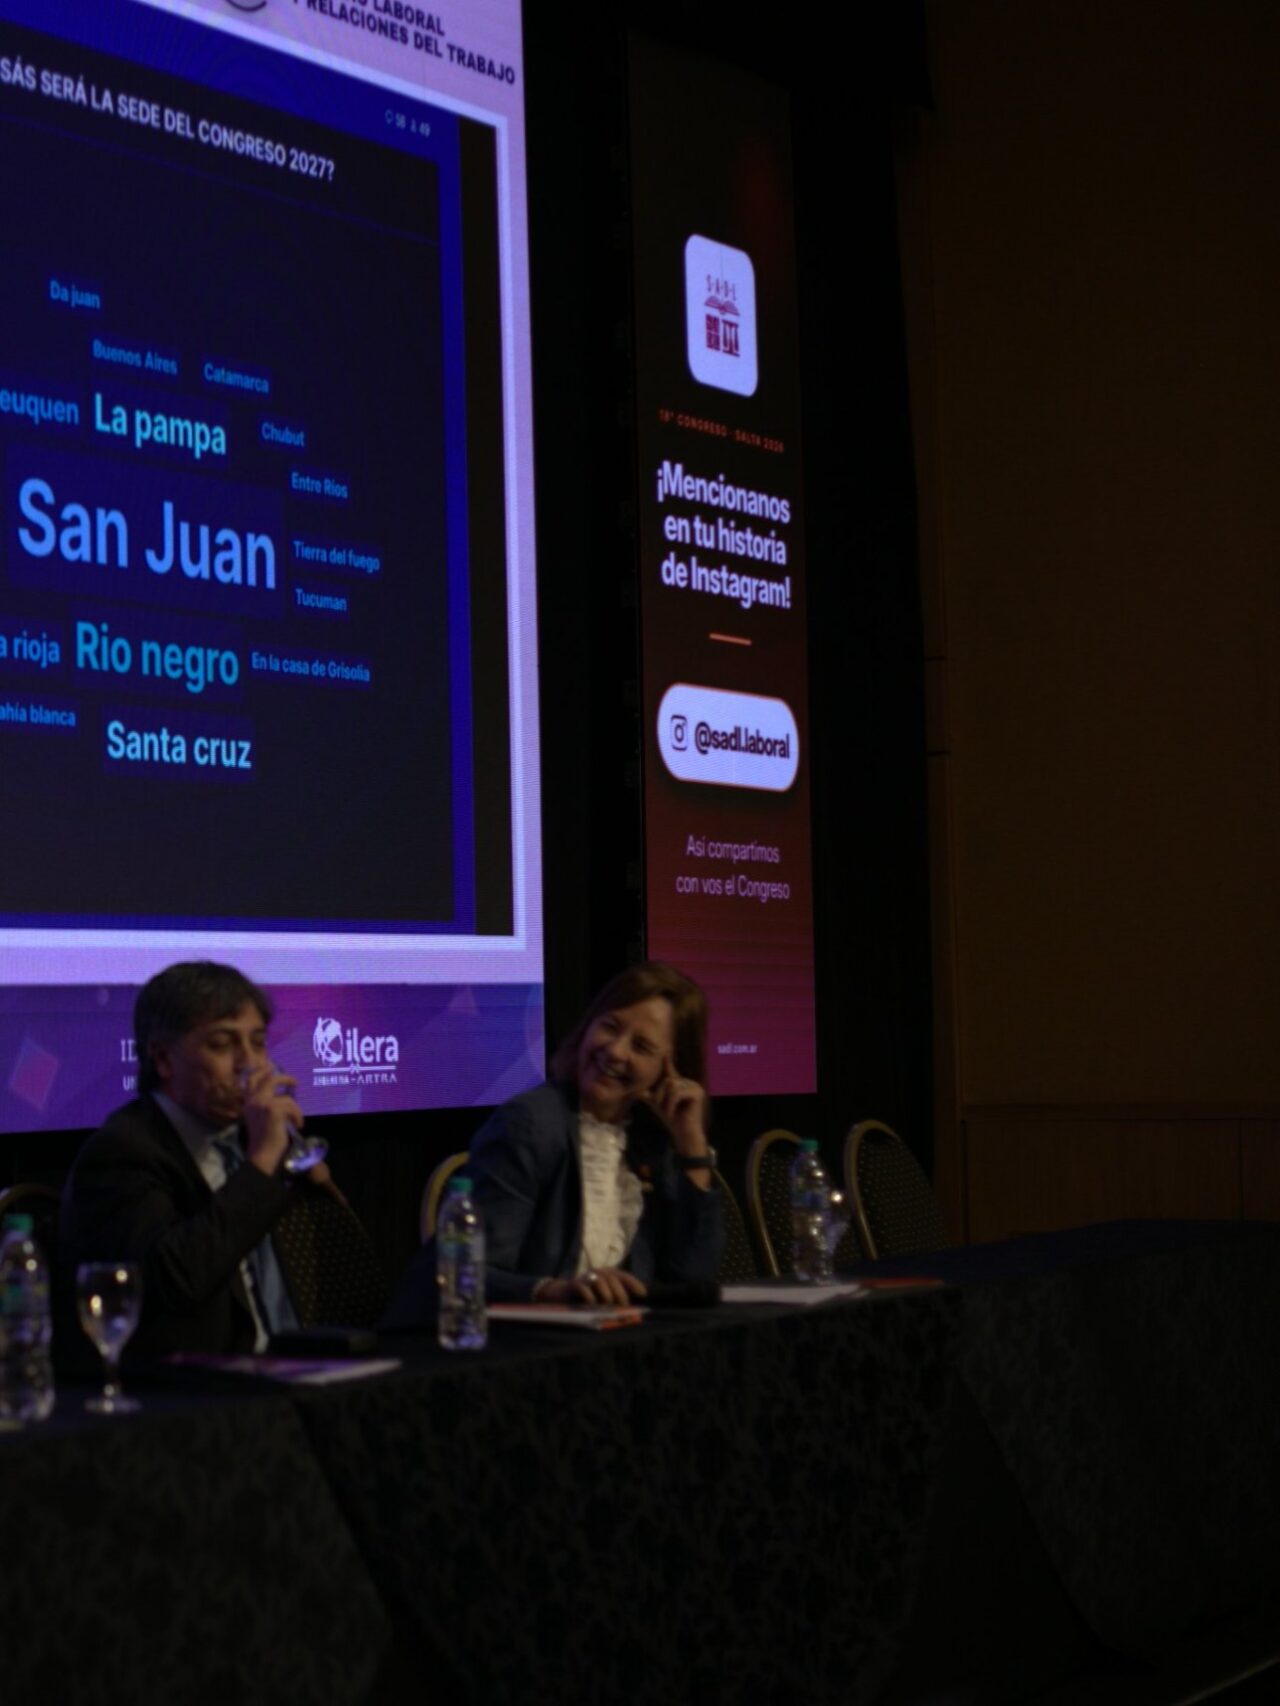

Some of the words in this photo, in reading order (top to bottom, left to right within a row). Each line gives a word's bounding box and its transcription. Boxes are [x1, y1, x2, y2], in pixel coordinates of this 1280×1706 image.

[373, 0, 445, 36] LABORAL
[413, 31, 443, 58] DEL
[447, 44, 516, 85] TRABAJO
[40, 69, 87, 107] SERÁ
[90, 84, 114, 115] LA
[117, 93, 161, 129] SEDE
[163, 107, 195, 140] DEL
[198, 118, 287, 166] CONGRESO
[288, 147, 336, 182] 2027?
[49, 278, 68, 301] Da
[70, 284, 101, 309] juan
[92, 337, 142, 368] Buenos
[144, 351, 179, 377] Aires
[204, 361, 270, 395] Catamarca
[94, 391, 128, 436] La
[134, 407, 227, 460] pampa
[261, 420, 306, 448] Chubut
[676, 413, 728, 437] CONGRESO
[291, 472, 321, 494] Entre
[657, 460, 792, 525] ¡Mencionanos
[18, 477, 129, 569] San
[144, 500, 276, 590] Juan
[664, 514, 691, 545] en
[693, 515, 716, 550] tu
[718, 517, 788, 566] historia
[293, 540, 327, 562] Tierra
[329, 547, 346, 566] del
[348, 548, 380, 573] fuego
[661, 551, 689, 589] de
[691, 556, 792, 610] Instagram!
[295, 588, 347, 611] Tucuman
[13, 630, 61, 668] rioja
[76, 620, 132, 674] Rio
[141, 639, 239, 694] negro
[251, 651, 267, 670] En
[269, 653, 280, 672] la
[282, 659, 309, 675] casa
[311, 660, 326, 677] de
[30, 703, 76, 727] blanca
[107, 719, 187, 764] Santa
[193, 735, 253, 769] cruz
[707, 840, 780, 864] compartimos
[676, 876, 699, 894] con
[701, 877, 722, 895] vos
[725, 874, 735, 896] el
[737, 875, 790, 903] Congreso
